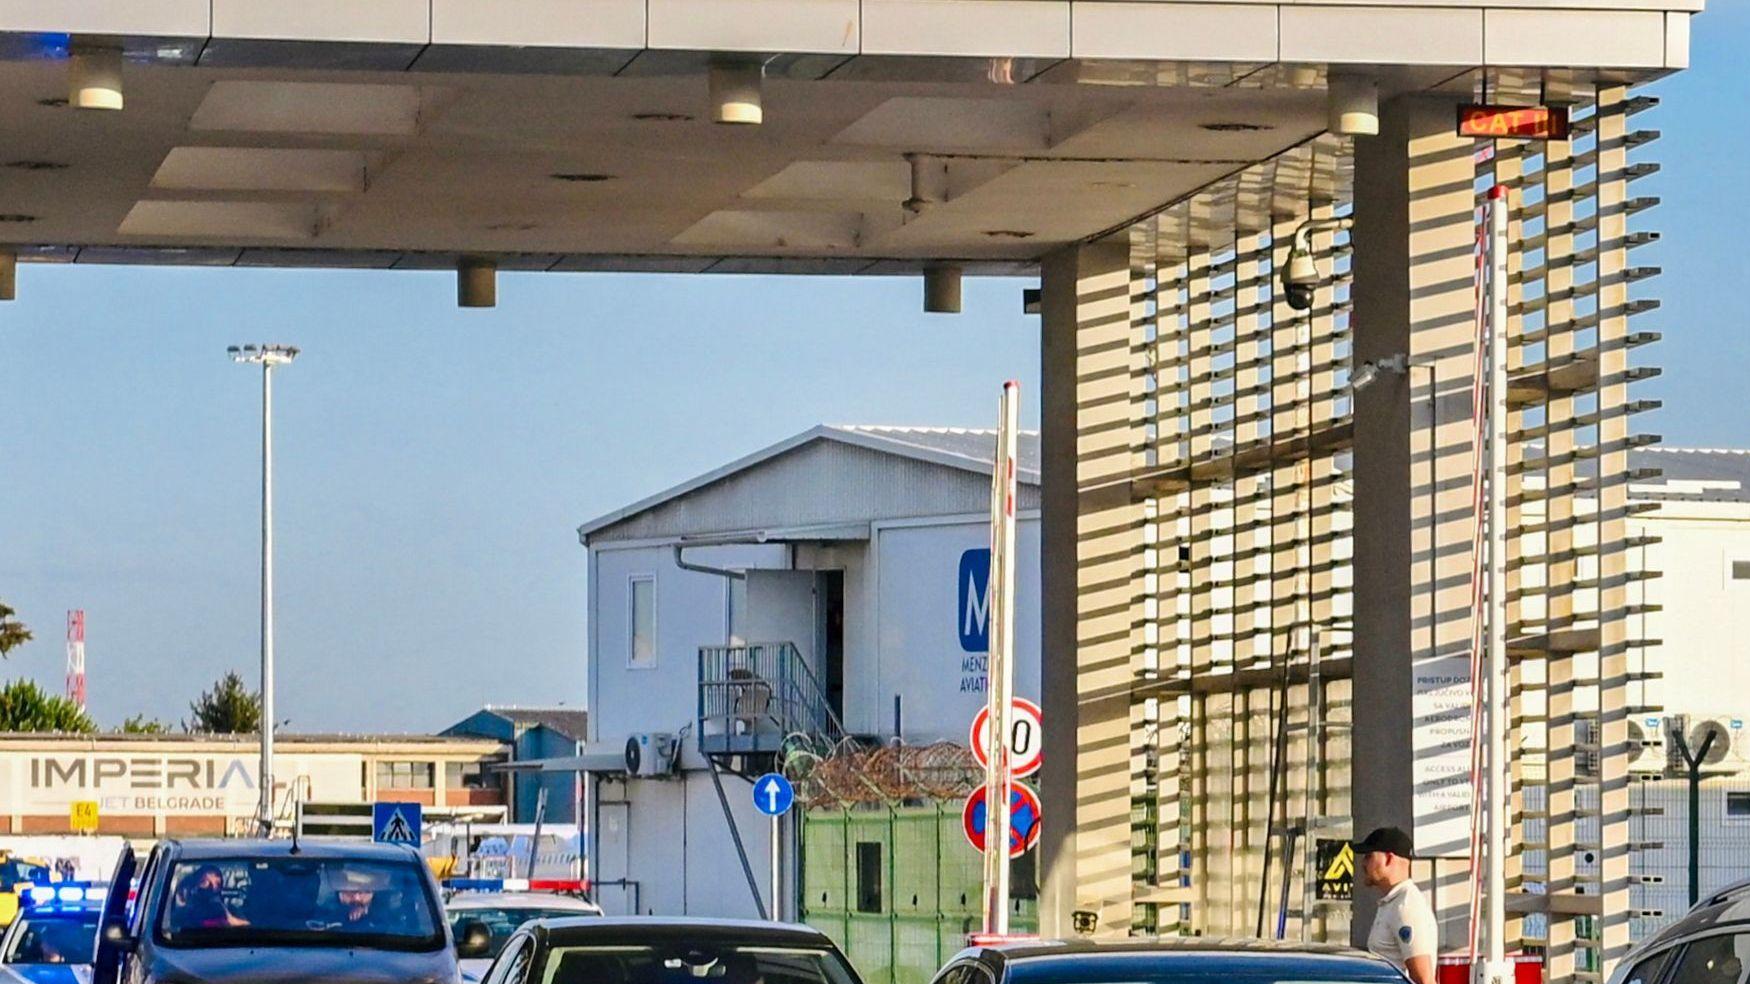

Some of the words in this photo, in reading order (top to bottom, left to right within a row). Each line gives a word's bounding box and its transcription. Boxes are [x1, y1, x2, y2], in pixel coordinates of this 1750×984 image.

[962, 656, 988, 672] MENZ
[960, 677, 988, 692] AVIATI
[1011, 719, 1031, 755] 0
[134, 796, 225, 810] BELGRADE
[1322, 882, 1354, 892] AVI
